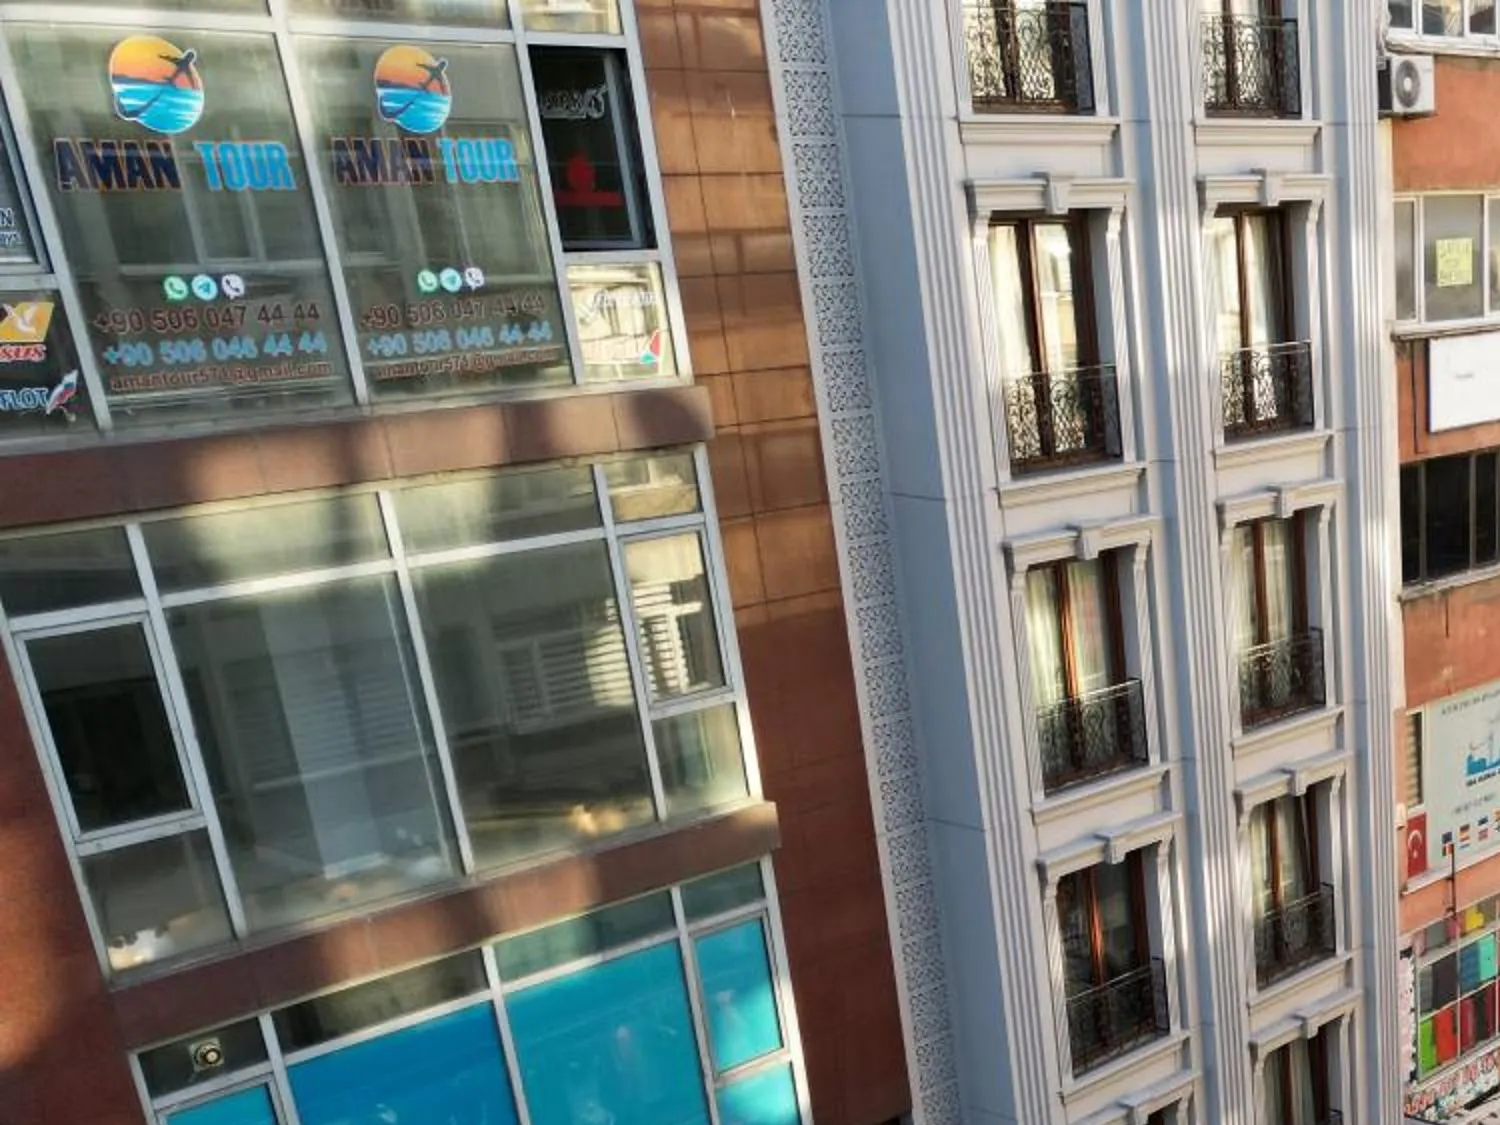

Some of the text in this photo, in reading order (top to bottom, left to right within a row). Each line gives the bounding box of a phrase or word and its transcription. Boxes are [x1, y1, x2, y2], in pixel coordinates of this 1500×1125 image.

[54, 138, 297, 192] AMAN TOUR
[331, 137, 520, 185] AMAN TOUR
[96, 302, 321, 335] +90 506 047 44 44
